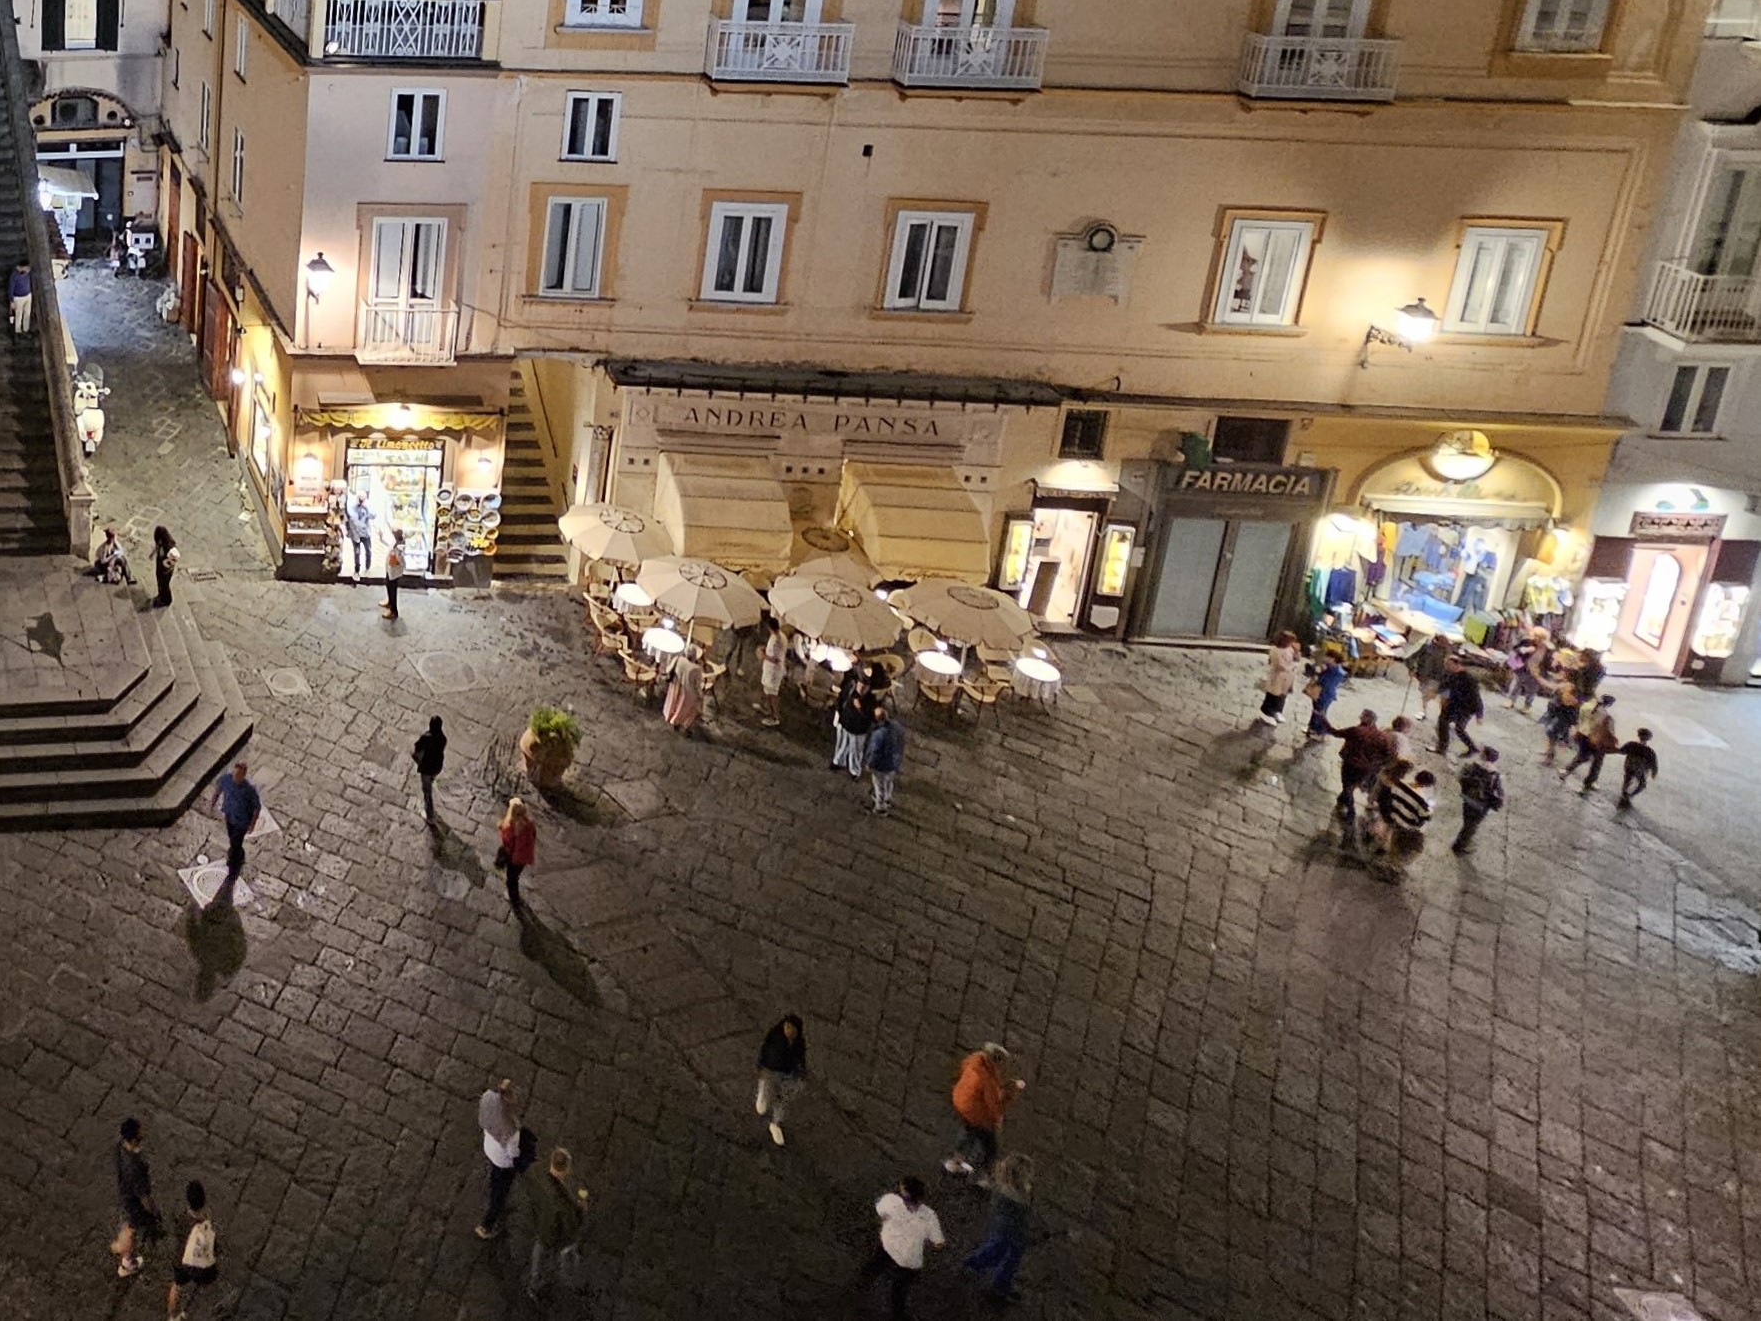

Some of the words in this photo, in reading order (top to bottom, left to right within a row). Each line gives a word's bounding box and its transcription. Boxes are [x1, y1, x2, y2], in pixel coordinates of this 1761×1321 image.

[684, 407, 808, 431] ANDREA
[834, 414, 939, 436] PANSA
[1180, 470, 1311, 496] FARMACIA
